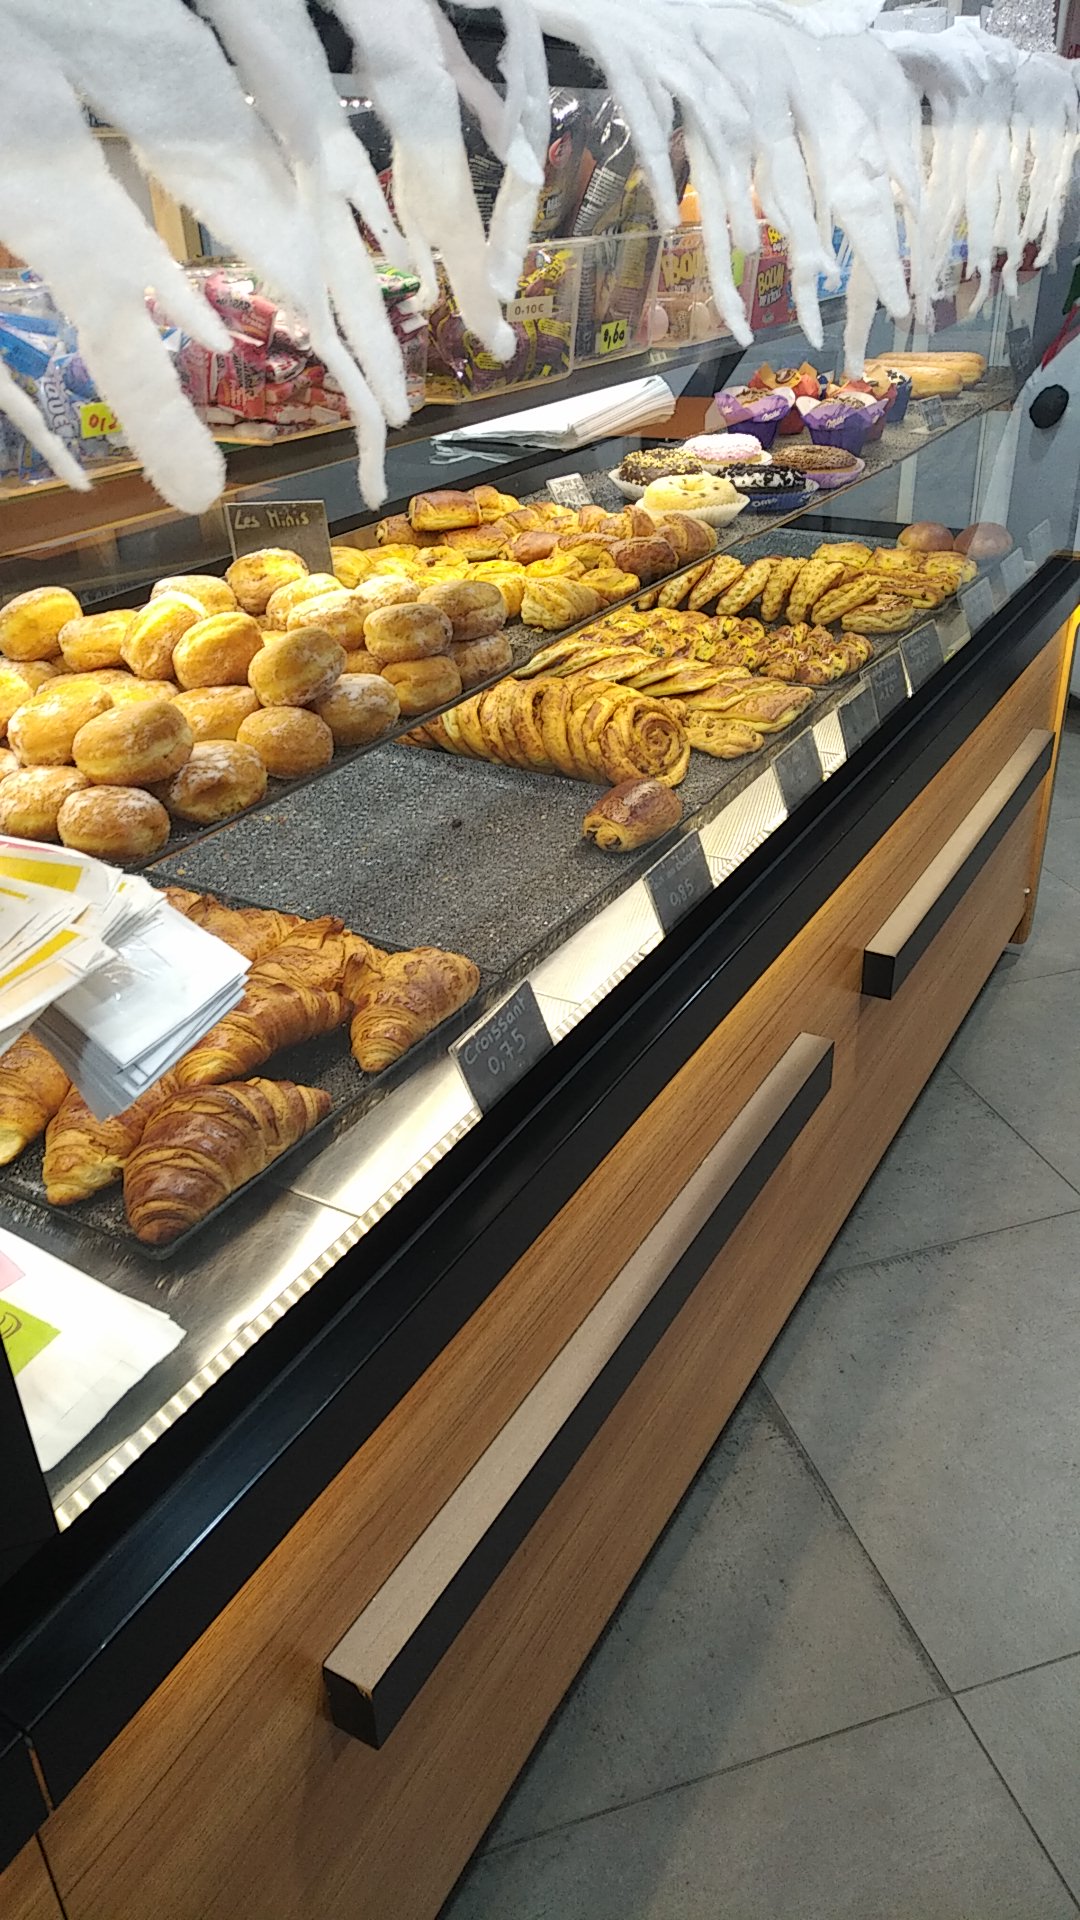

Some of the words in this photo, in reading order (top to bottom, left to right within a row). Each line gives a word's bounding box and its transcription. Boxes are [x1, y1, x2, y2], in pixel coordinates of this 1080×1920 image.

[234, 508, 260, 530] Les
[266, 507, 310, 528] Minis
[669, 878, 694, 907] 0,85
[463, 994, 526, 1065] Croissant
[487, 1028, 526, 1076] 0,75
